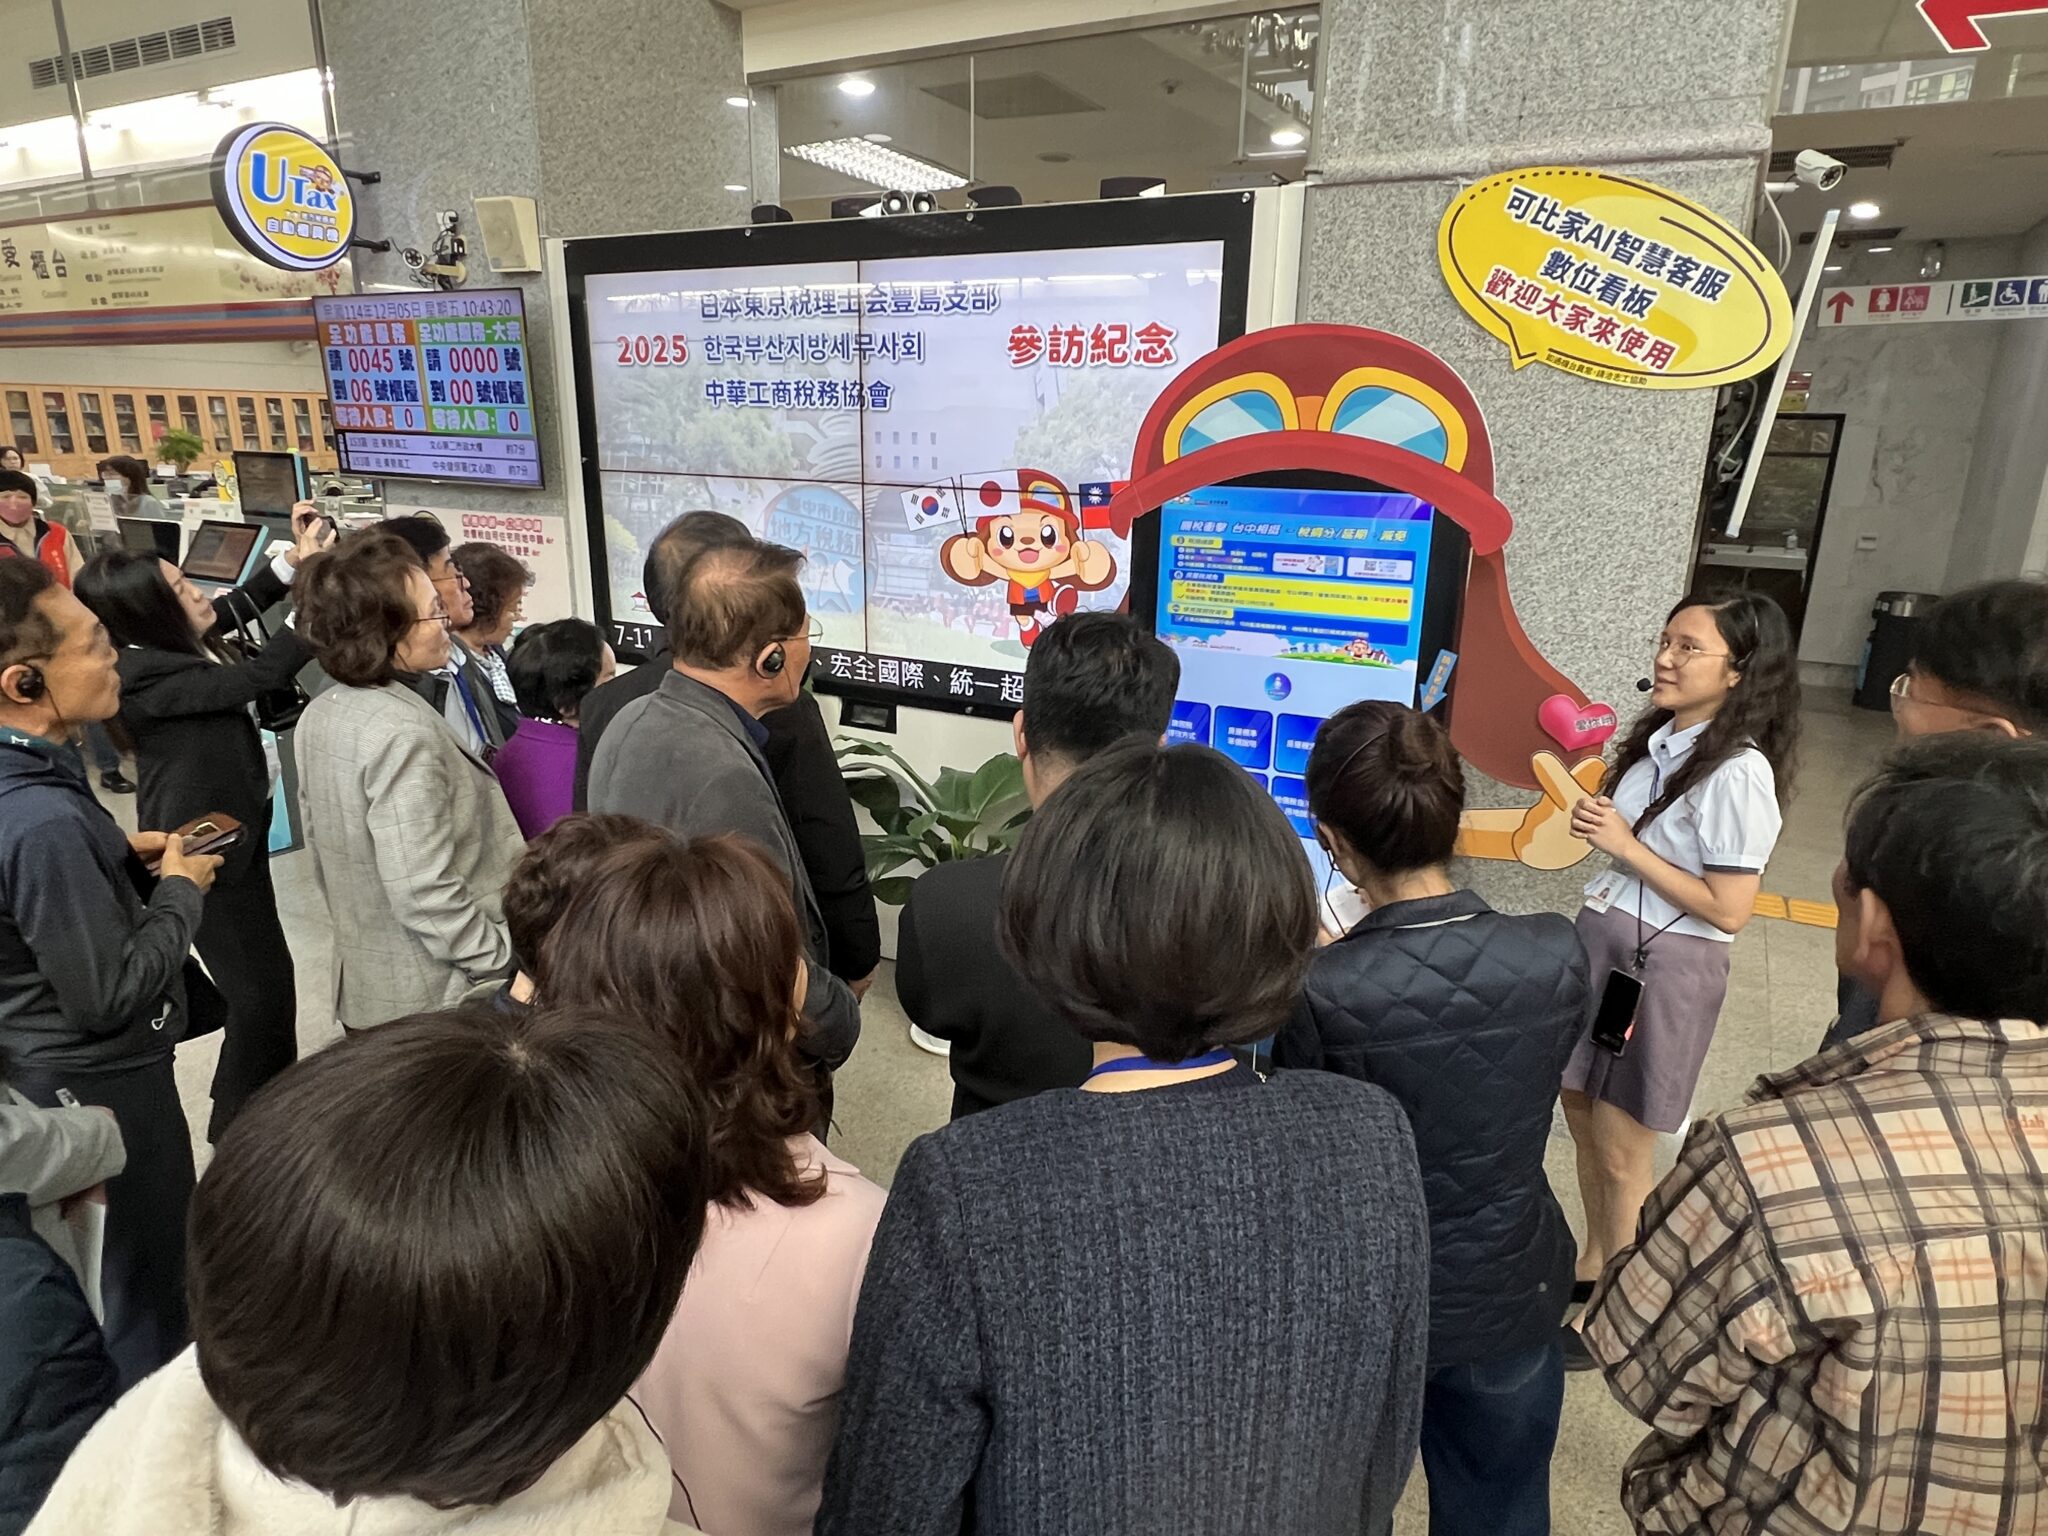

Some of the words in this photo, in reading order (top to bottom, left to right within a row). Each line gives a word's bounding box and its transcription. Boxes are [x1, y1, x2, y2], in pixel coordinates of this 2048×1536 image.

[1508, 187, 1731, 302] 可比家AI智慧客服
[1541, 250, 1657, 319] 數位看板
[425, 300, 459, 318] 星期五
[463, 299, 512, 316] 10:43:20
[1485, 268, 1677, 371] 歡迎大家來使用
[617, 335, 688, 364] 2025
[704, 331, 925, 363] 한국부산지방세무사회
[1007, 322, 1176, 367] 參訪紀念
[349, 347, 394, 374] 0045
[449, 346, 499, 374] 0000
[351, 378, 373, 403] 06
[450, 379, 474, 405] 00
[705, 379, 892, 409] 中華工商稅務協會
[404, 408, 413, 429] 0
[509, 411, 519, 432] 0
